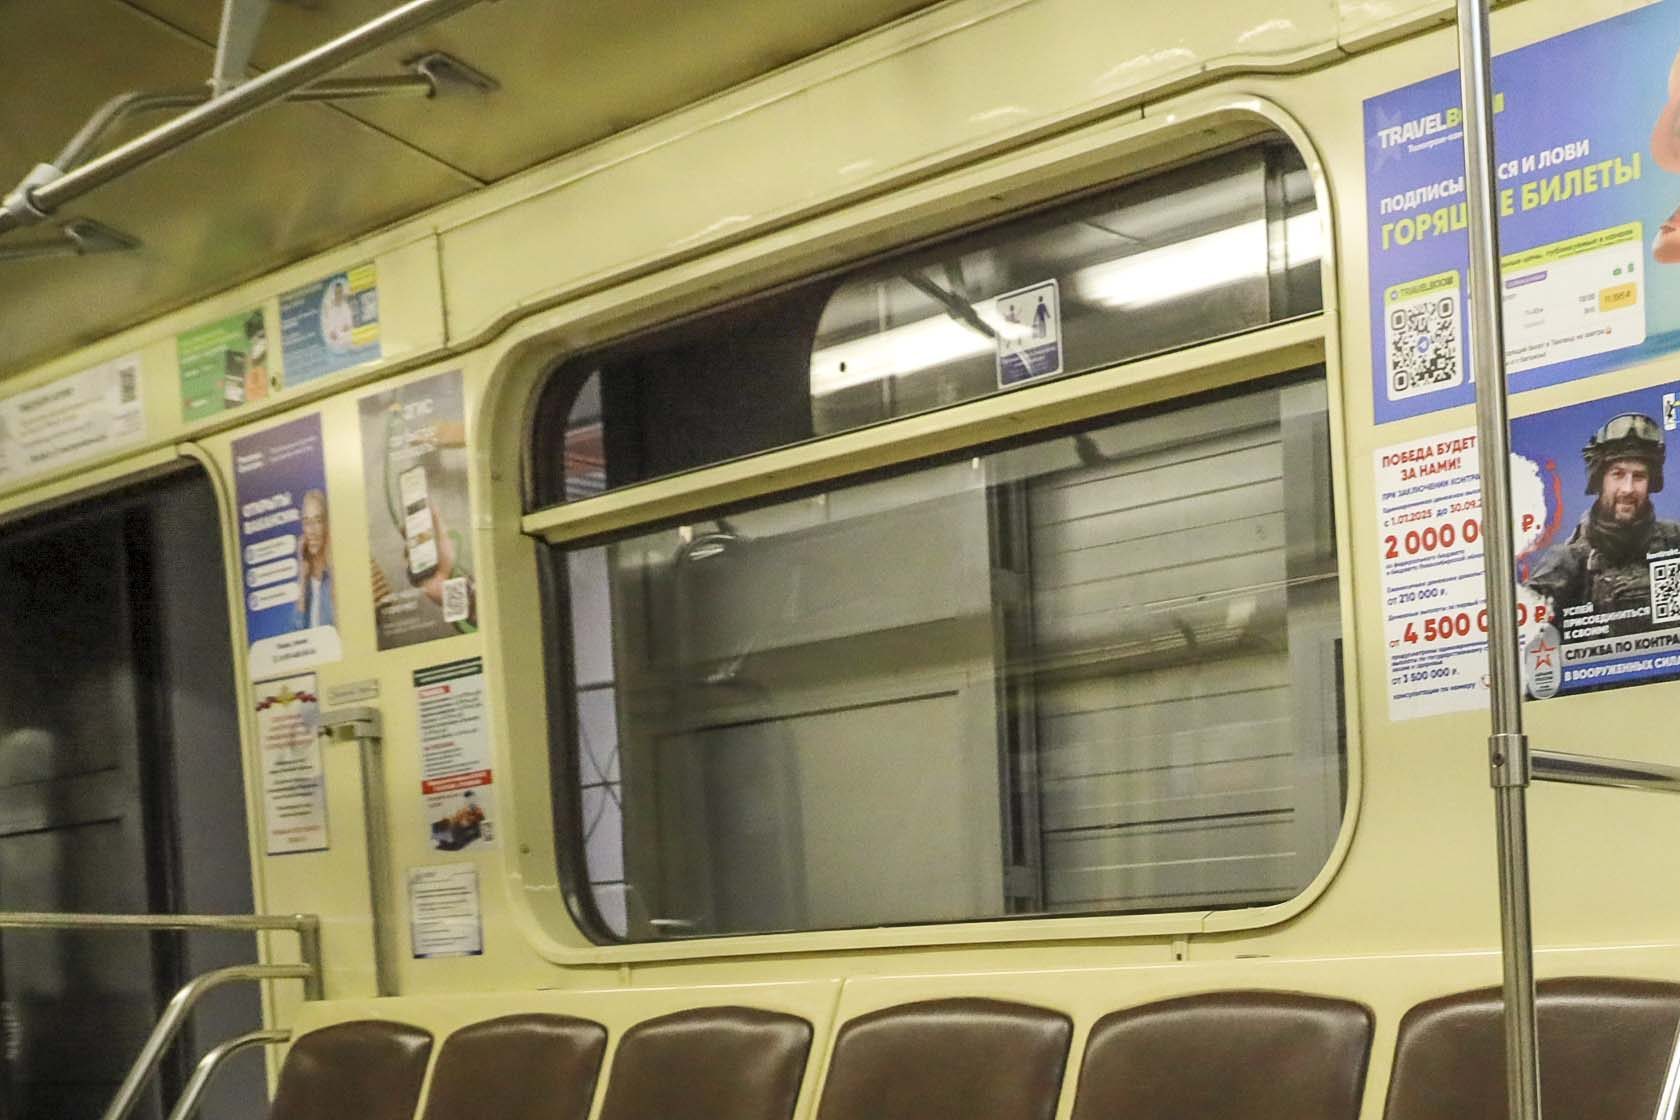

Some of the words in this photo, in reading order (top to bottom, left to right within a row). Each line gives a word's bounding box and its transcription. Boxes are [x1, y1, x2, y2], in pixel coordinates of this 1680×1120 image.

[1522, 153, 1536, 175] И
[1538, 138, 1590, 171] ЛОВИ
[1521, 152, 1642, 212] БИЛЕТЫ
[1382, 445, 1433, 468] ПОБЕДА
[1437, 435, 1477, 456] БУДЕТ
[1401, 467, 1417, 481] ЗА
[1420, 457, 1462, 477] НАМИ!
[1436, 508, 1448, 518] до
[1405, 523, 1456, 555] 000
[1403, 622, 1419, 645] 4
[1424, 612, 1471, 642] 500
[1563, 630, 1571, 641] К
[1565, 643, 1613, 661] СЛУЖБА
[1615, 640, 1633, 653] ПО
[1564, 671, 1573, 682] В
[1573, 659, 1654, 680] ВООРУЖЕННЫХ
